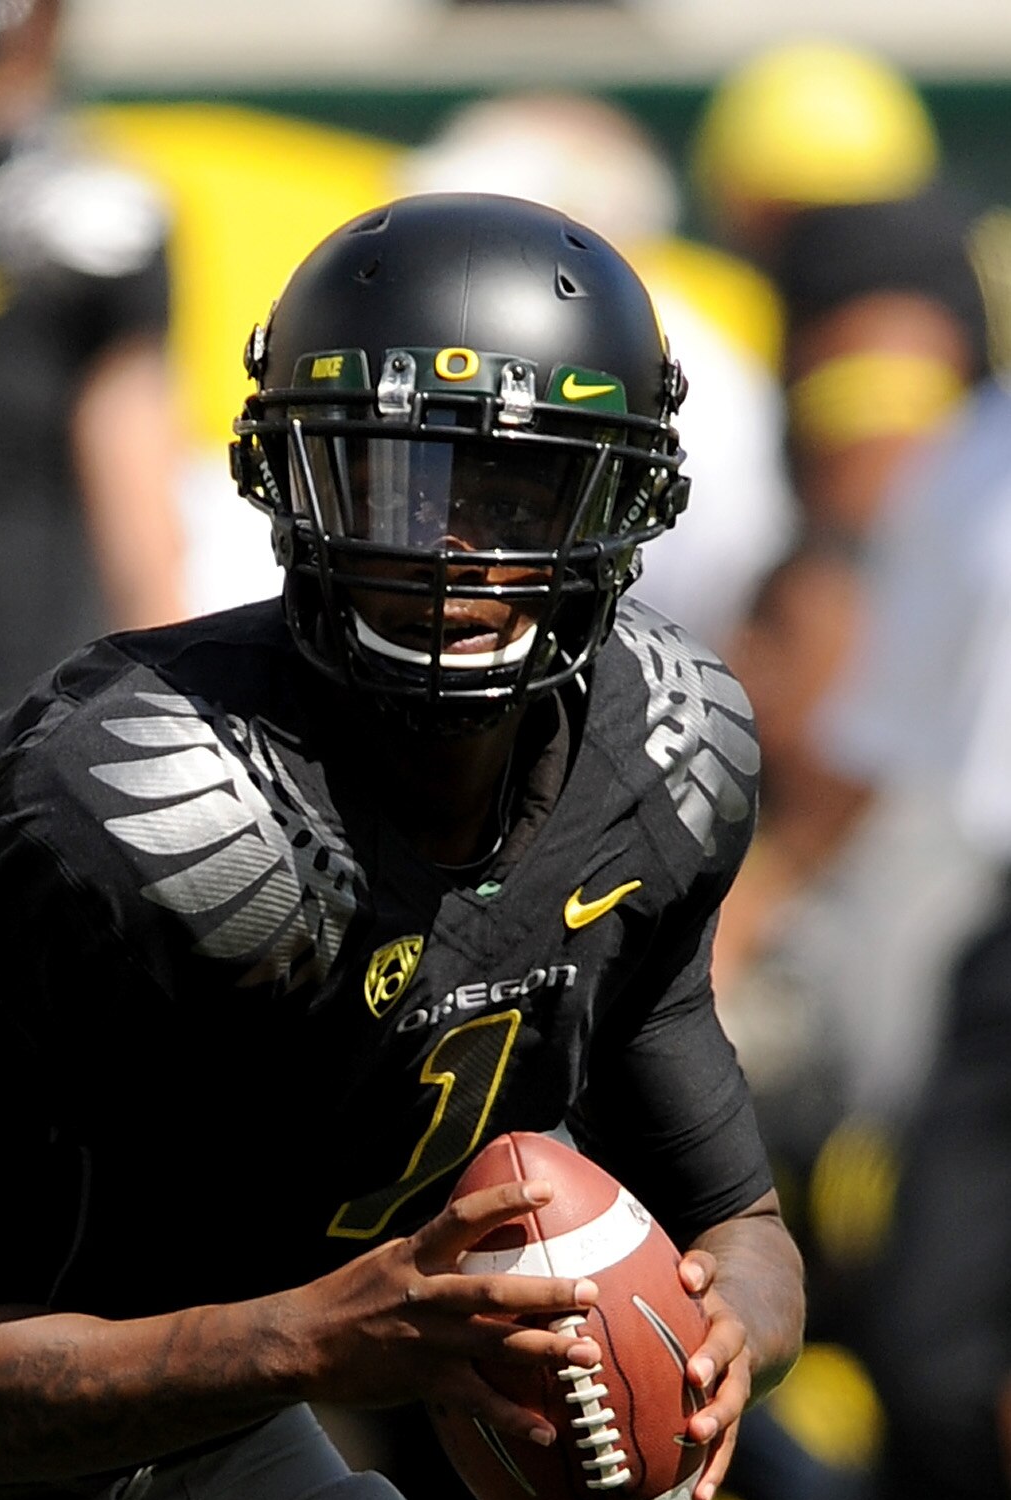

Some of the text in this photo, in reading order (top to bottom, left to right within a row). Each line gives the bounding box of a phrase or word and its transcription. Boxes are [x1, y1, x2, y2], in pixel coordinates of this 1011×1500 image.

[435, 347, 480, 382] O
[373, 971, 405, 1005] 10
[326, 1008, 523, 1240] 1
